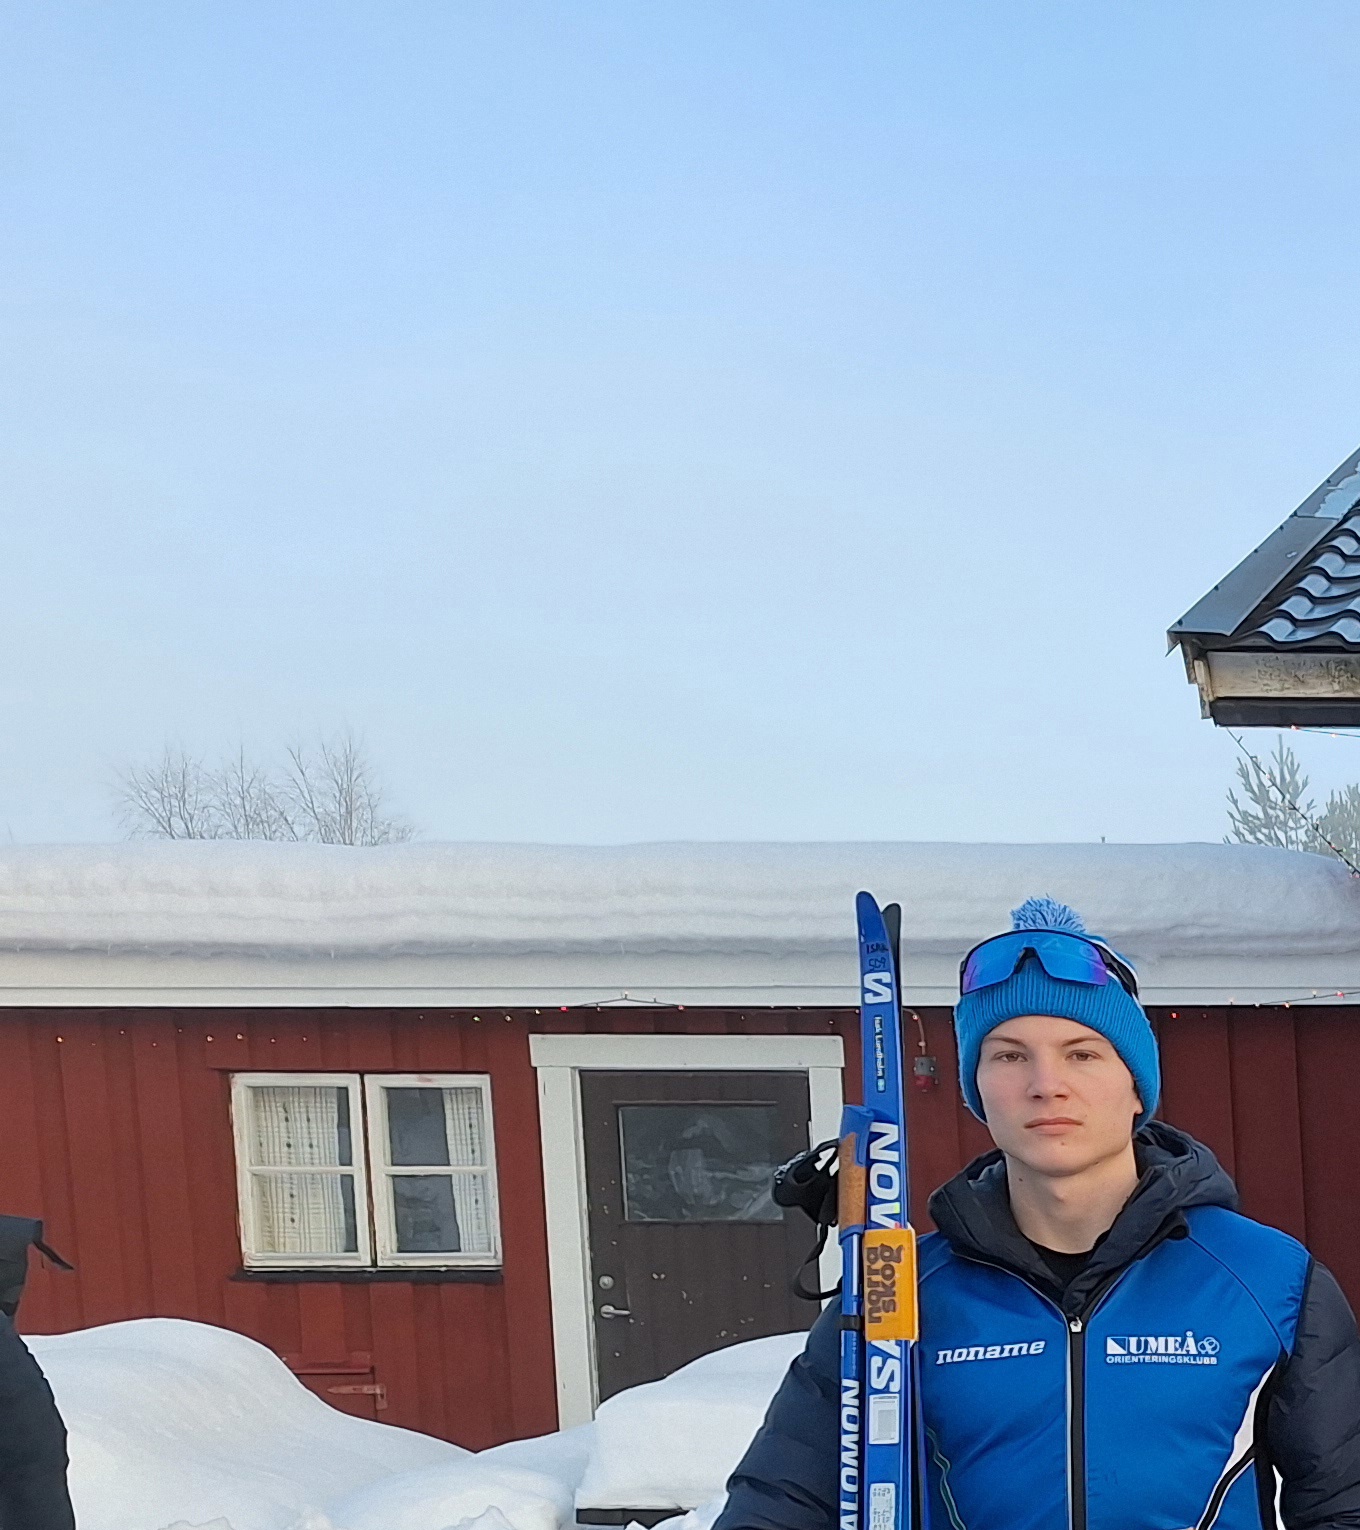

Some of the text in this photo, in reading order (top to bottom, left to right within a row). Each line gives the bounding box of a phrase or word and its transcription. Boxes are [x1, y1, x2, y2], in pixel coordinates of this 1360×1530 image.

[866, 1246, 881, 1324] norra
[879, 1243, 903, 1314] skog
[935, 1340, 1046, 1365] noname
[1128, 1331, 1198, 1355] UMEÅ
[1106, 1355, 1218, 1365] ORIENTERINGSKLUBB
